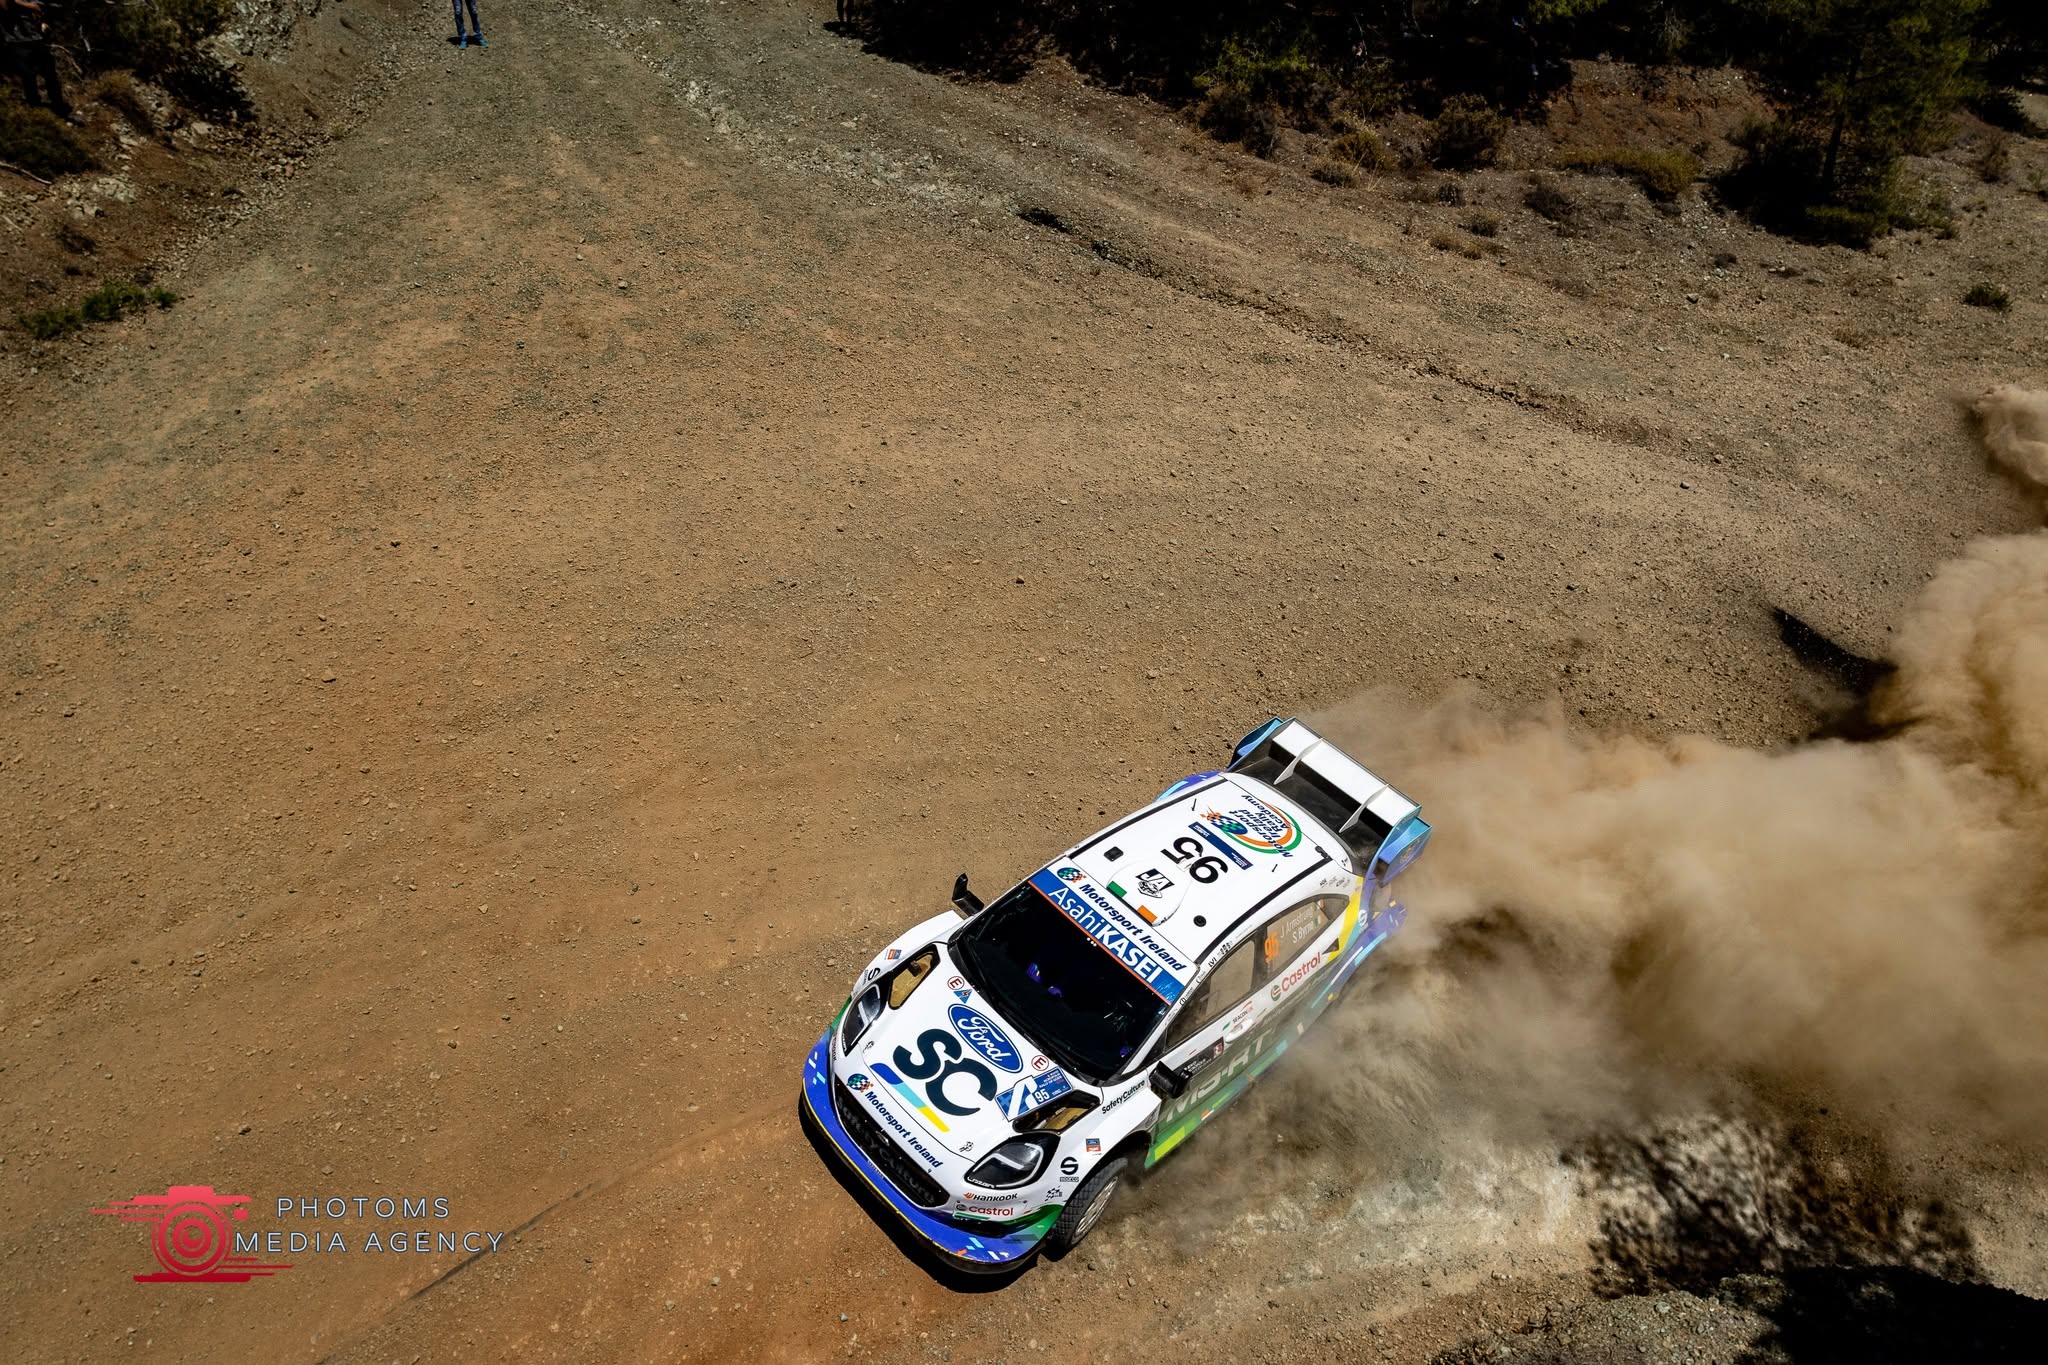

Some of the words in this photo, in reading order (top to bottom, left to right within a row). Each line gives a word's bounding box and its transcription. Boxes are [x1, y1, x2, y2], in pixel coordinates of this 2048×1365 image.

[1229, 810, 1293, 858] Motorsport
[1238, 809, 1281, 838] Ireland
[1241, 794, 1289, 829] Academy
[1254, 812, 1283, 832] Rally
[1160, 837, 1229, 884] 95
[1048, 887, 1163, 984] AsahiKASEI
[1079, 883, 1143, 937] Motorsport
[1139, 935, 1187, 971] Ireland
[1281, 952, 1321, 992] Castrol
[957, 1016, 1011, 1062] Ford
[893, 1028, 998, 1116] SC
[1034, 1088, 1050, 1102] 95
[1101, 1080, 1146, 1114] SafetyCulture
[865, 1091, 911, 1138] Motorsport
[908, 1137, 944, 1168] Ireland
